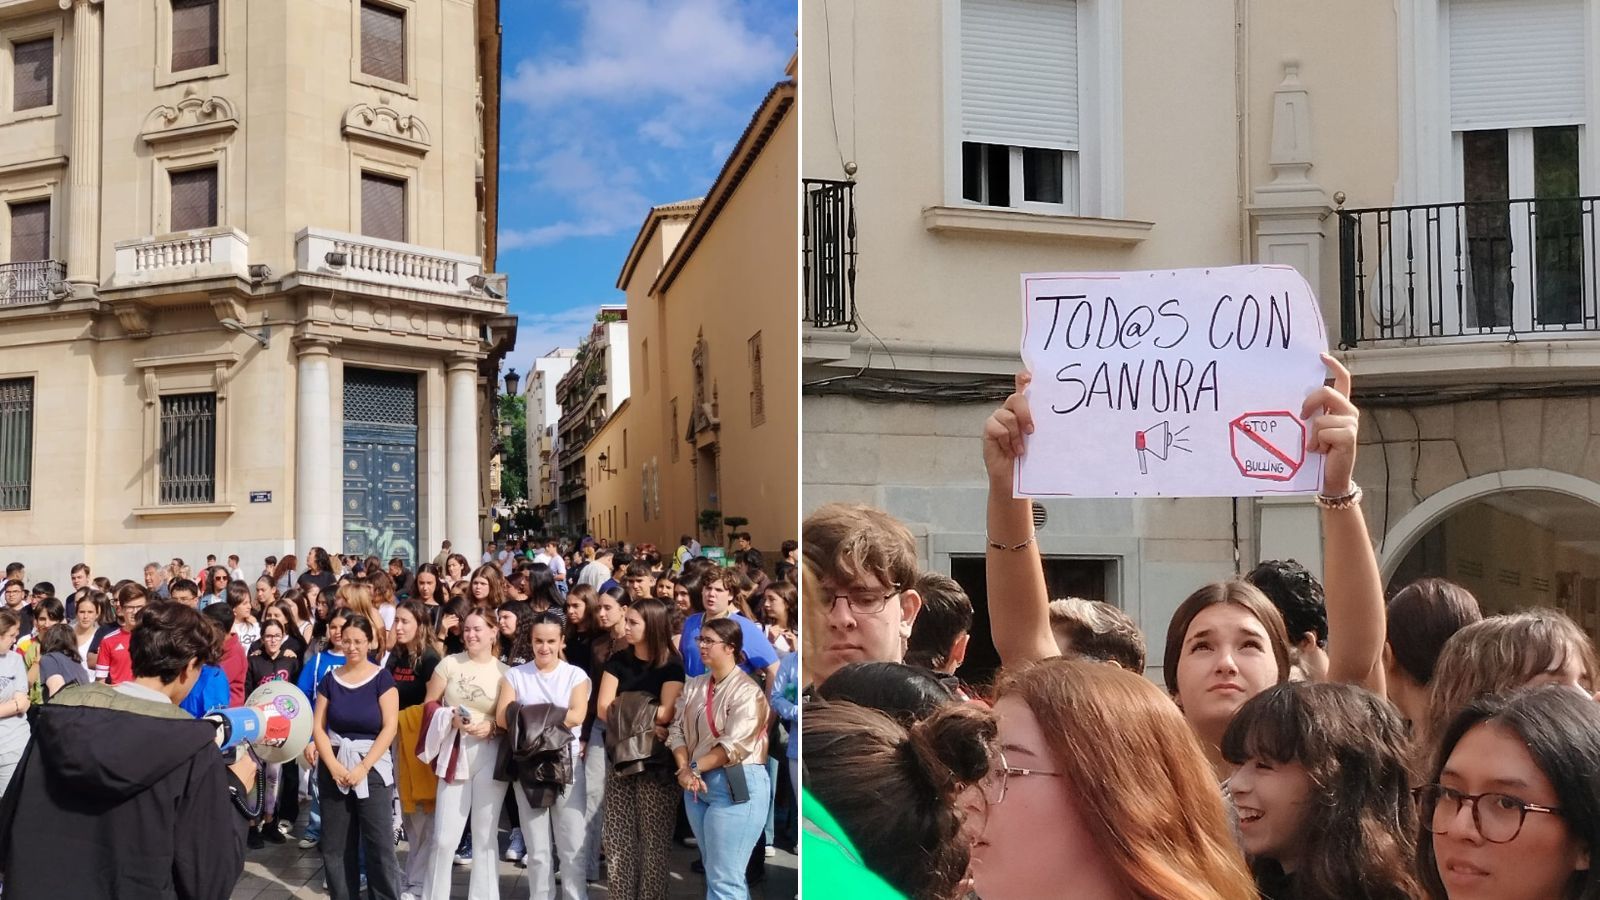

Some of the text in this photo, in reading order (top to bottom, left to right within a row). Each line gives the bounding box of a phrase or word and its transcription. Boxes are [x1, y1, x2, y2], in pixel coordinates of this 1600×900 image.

[1035, 290, 1291, 351] TOD@S CON
[1051, 359, 1218, 415] SANDRA
[1244, 420, 1278, 434] STOP
